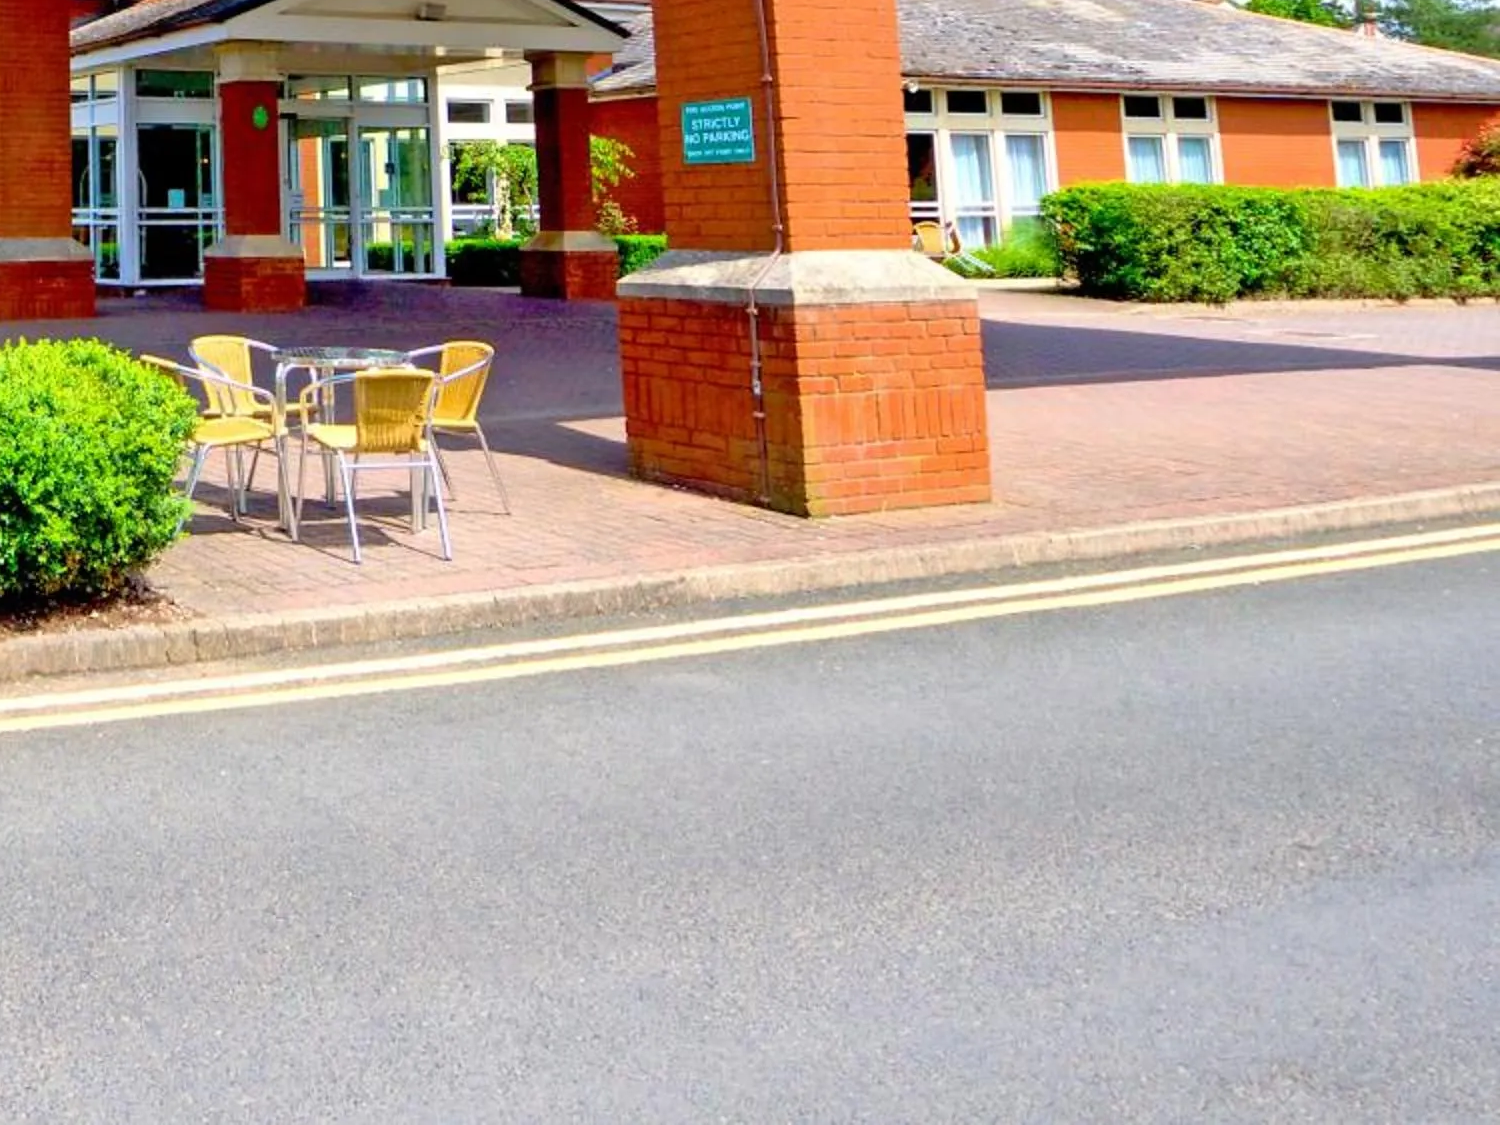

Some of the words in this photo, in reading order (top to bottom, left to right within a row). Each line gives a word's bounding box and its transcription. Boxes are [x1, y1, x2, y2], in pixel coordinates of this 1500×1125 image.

[691, 117, 740, 130] STRICTLY
[684, 133, 700, 144] NO
[703, 129, 749, 143] PARKING
